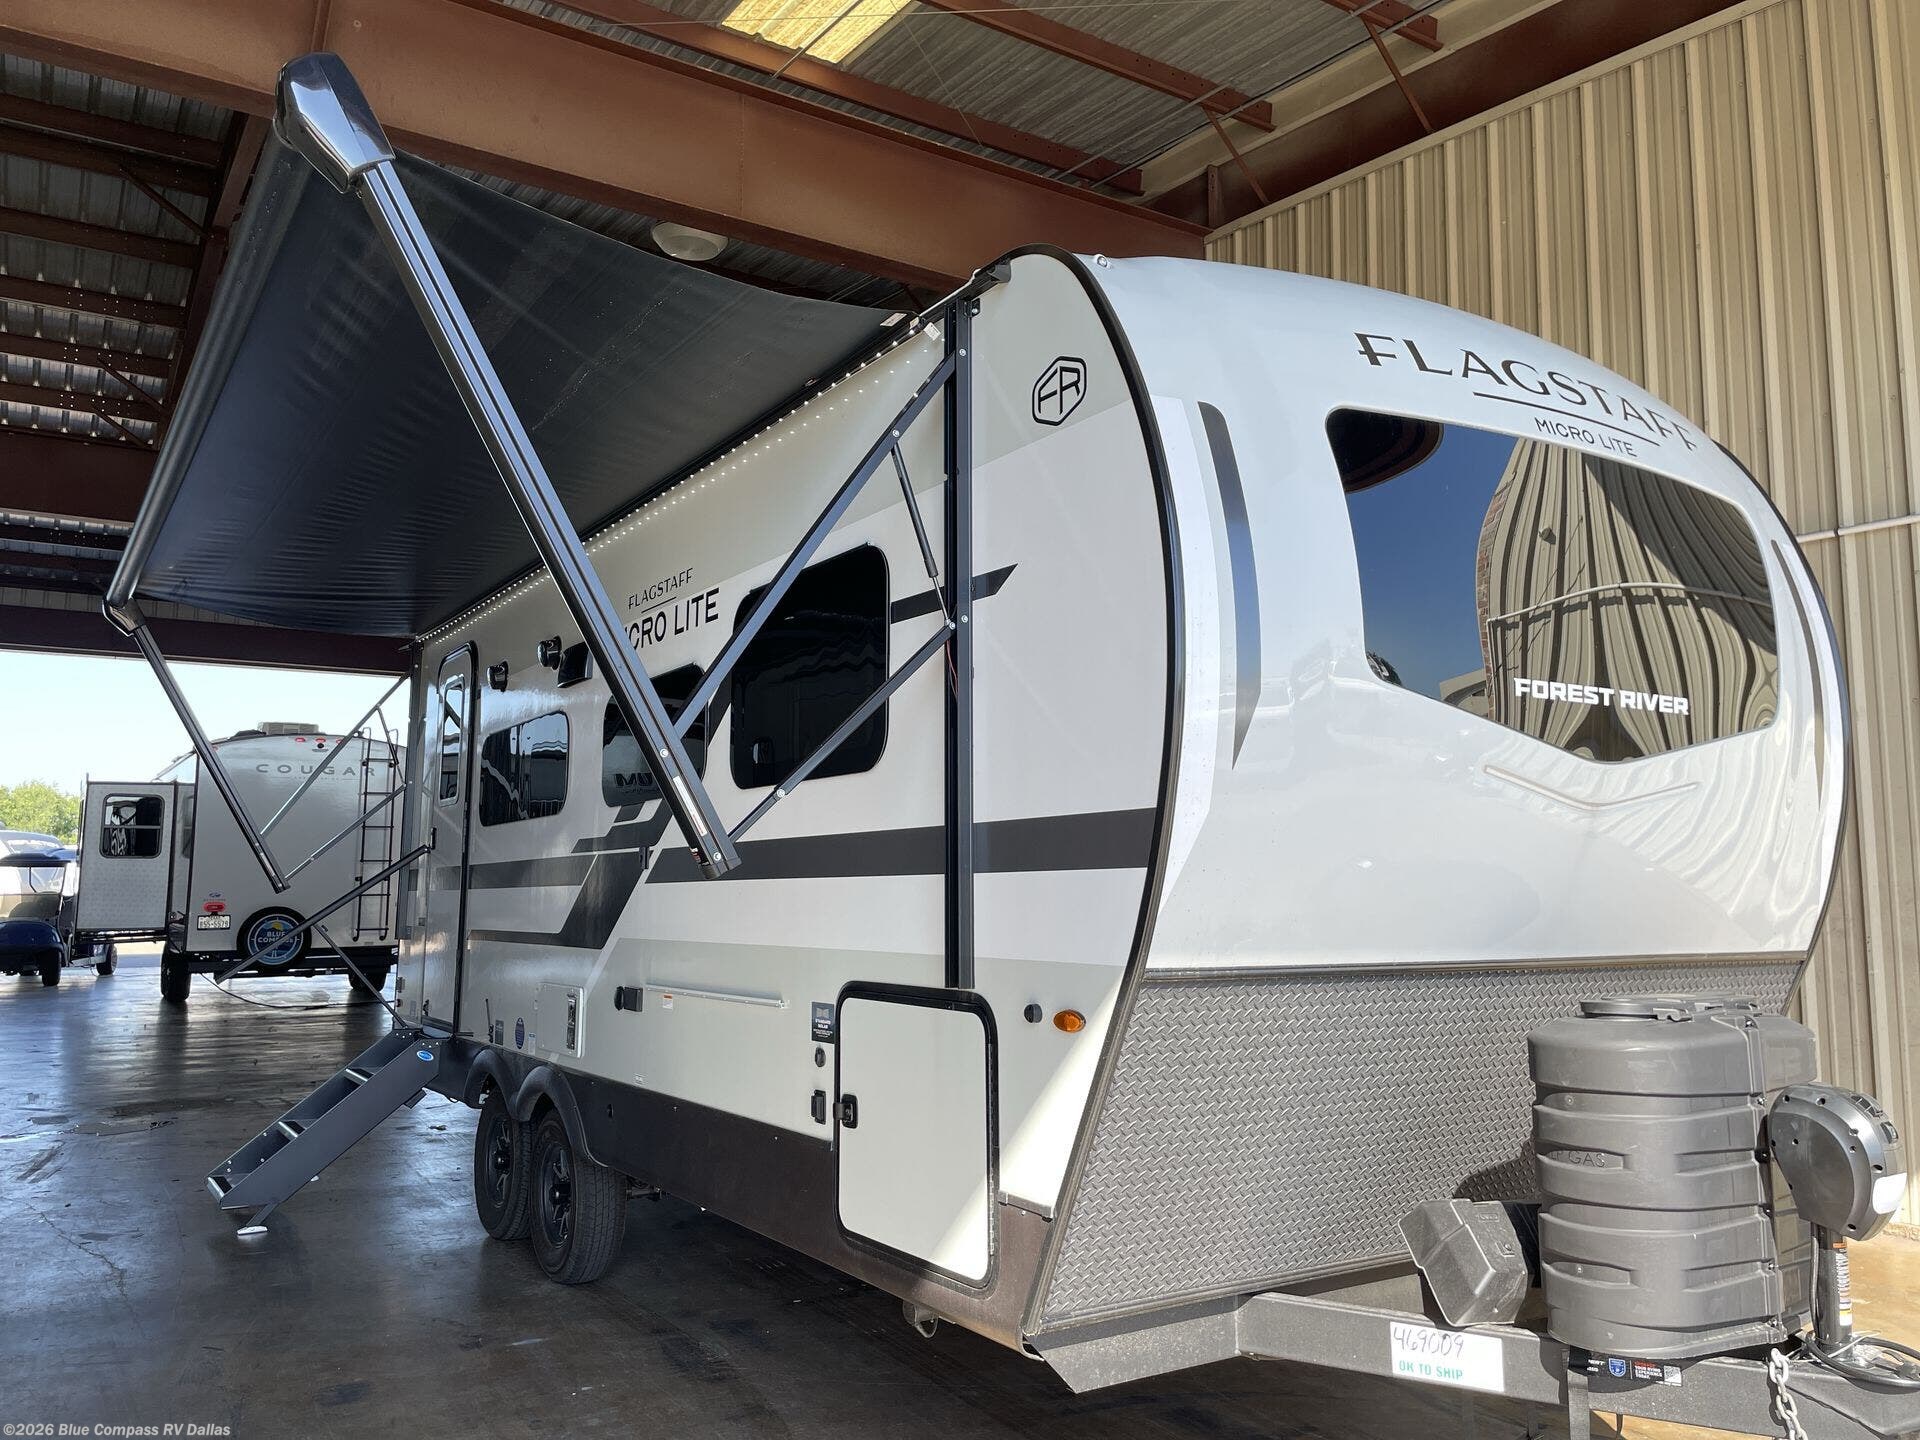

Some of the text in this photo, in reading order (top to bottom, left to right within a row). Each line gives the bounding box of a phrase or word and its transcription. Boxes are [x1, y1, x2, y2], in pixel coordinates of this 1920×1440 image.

[1354, 332, 1697, 451] FLAGSTAFF
[1533, 416, 1638, 458] MICRO LITE
[628, 567, 693, 610] FLAGSTAFF
[624, 587, 720, 650] CRO LITE
[1513, 677, 1690, 716] FOREST RIVER
[255, 763, 376, 777] COUGAR
[1569, 1150, 1606, 1168] GAS
[1393, 1326, 1465, 1358] 469009
[1398, 1360, 1464, 1381] OK TO SHIP
